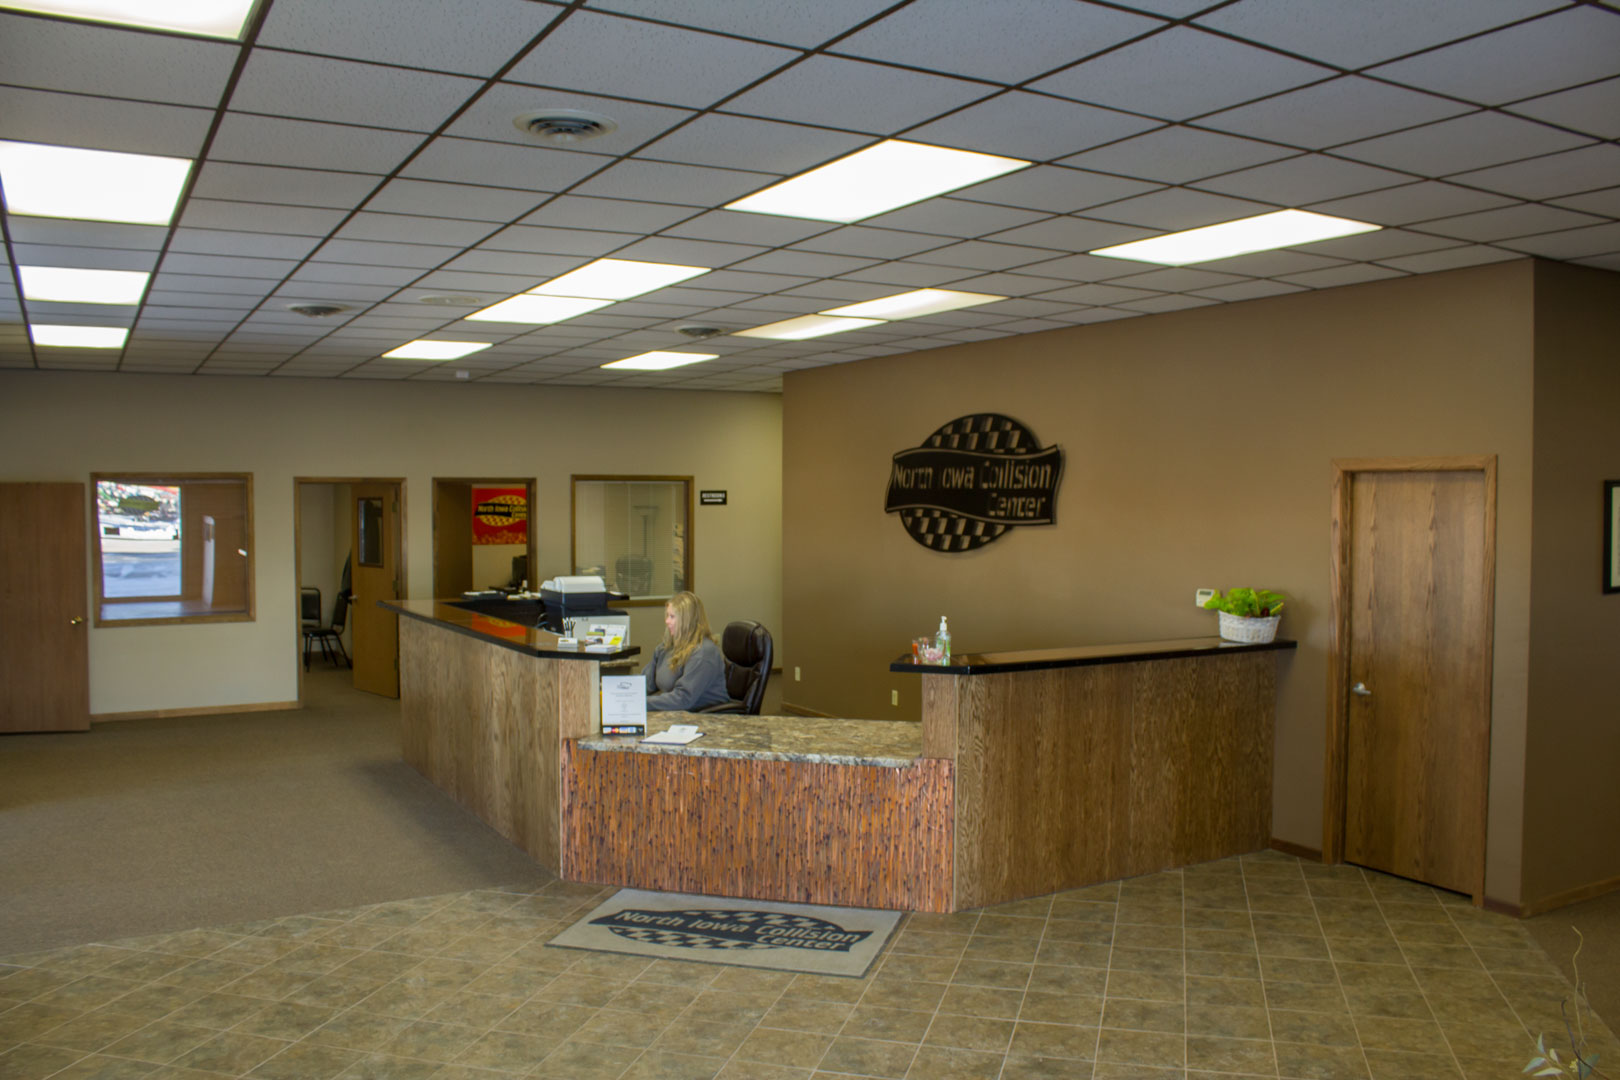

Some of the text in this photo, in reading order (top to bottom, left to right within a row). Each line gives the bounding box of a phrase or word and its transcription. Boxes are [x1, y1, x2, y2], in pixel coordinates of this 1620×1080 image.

[893, 462, 934, 489] North
[981, 458, 1052, 489] Collision
[987, 491, 1047, 518] Center
[614, 911, 861, 943] North Iowa Collision
[756, 934, 847, 950] Center
